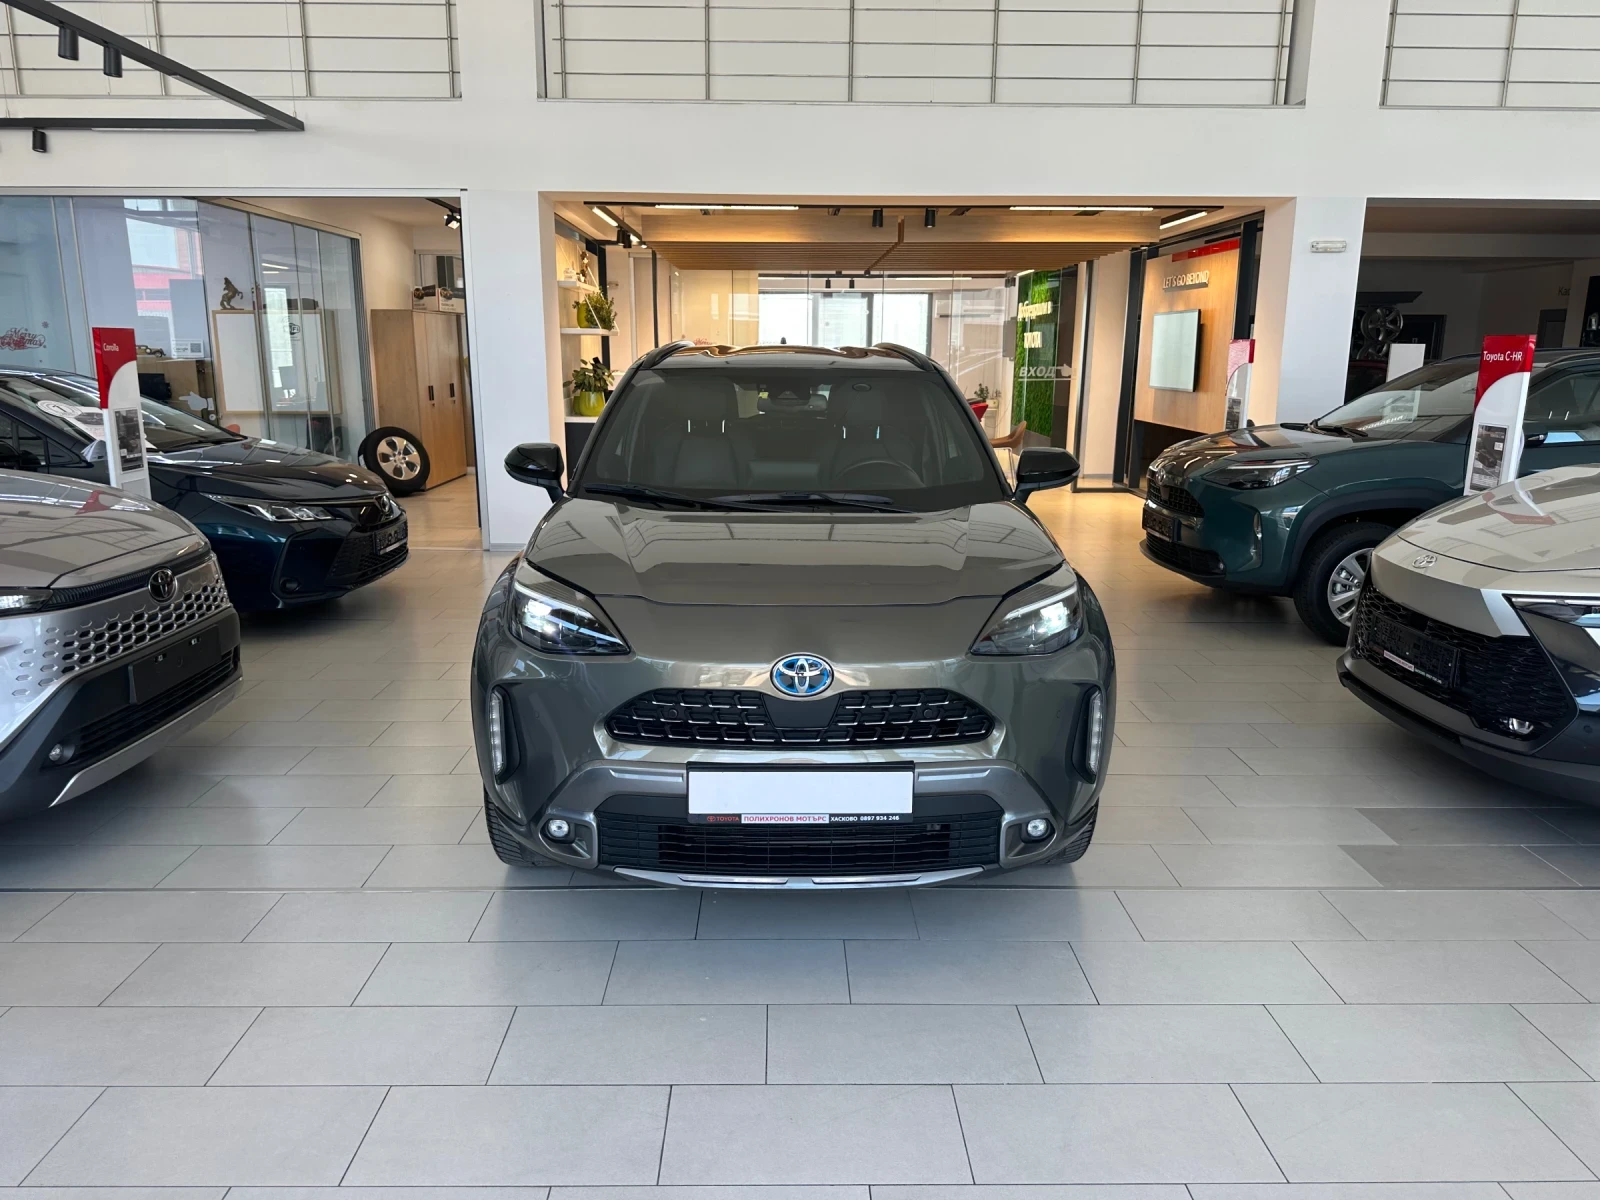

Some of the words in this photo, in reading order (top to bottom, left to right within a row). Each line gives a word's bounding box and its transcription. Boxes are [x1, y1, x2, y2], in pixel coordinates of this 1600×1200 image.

[1483, 350, 1505, 363] Toyota
[1504, 350, 1523, 362] C-HR
[743, 815, 795, 823] ПОЛИХРОНОВ
